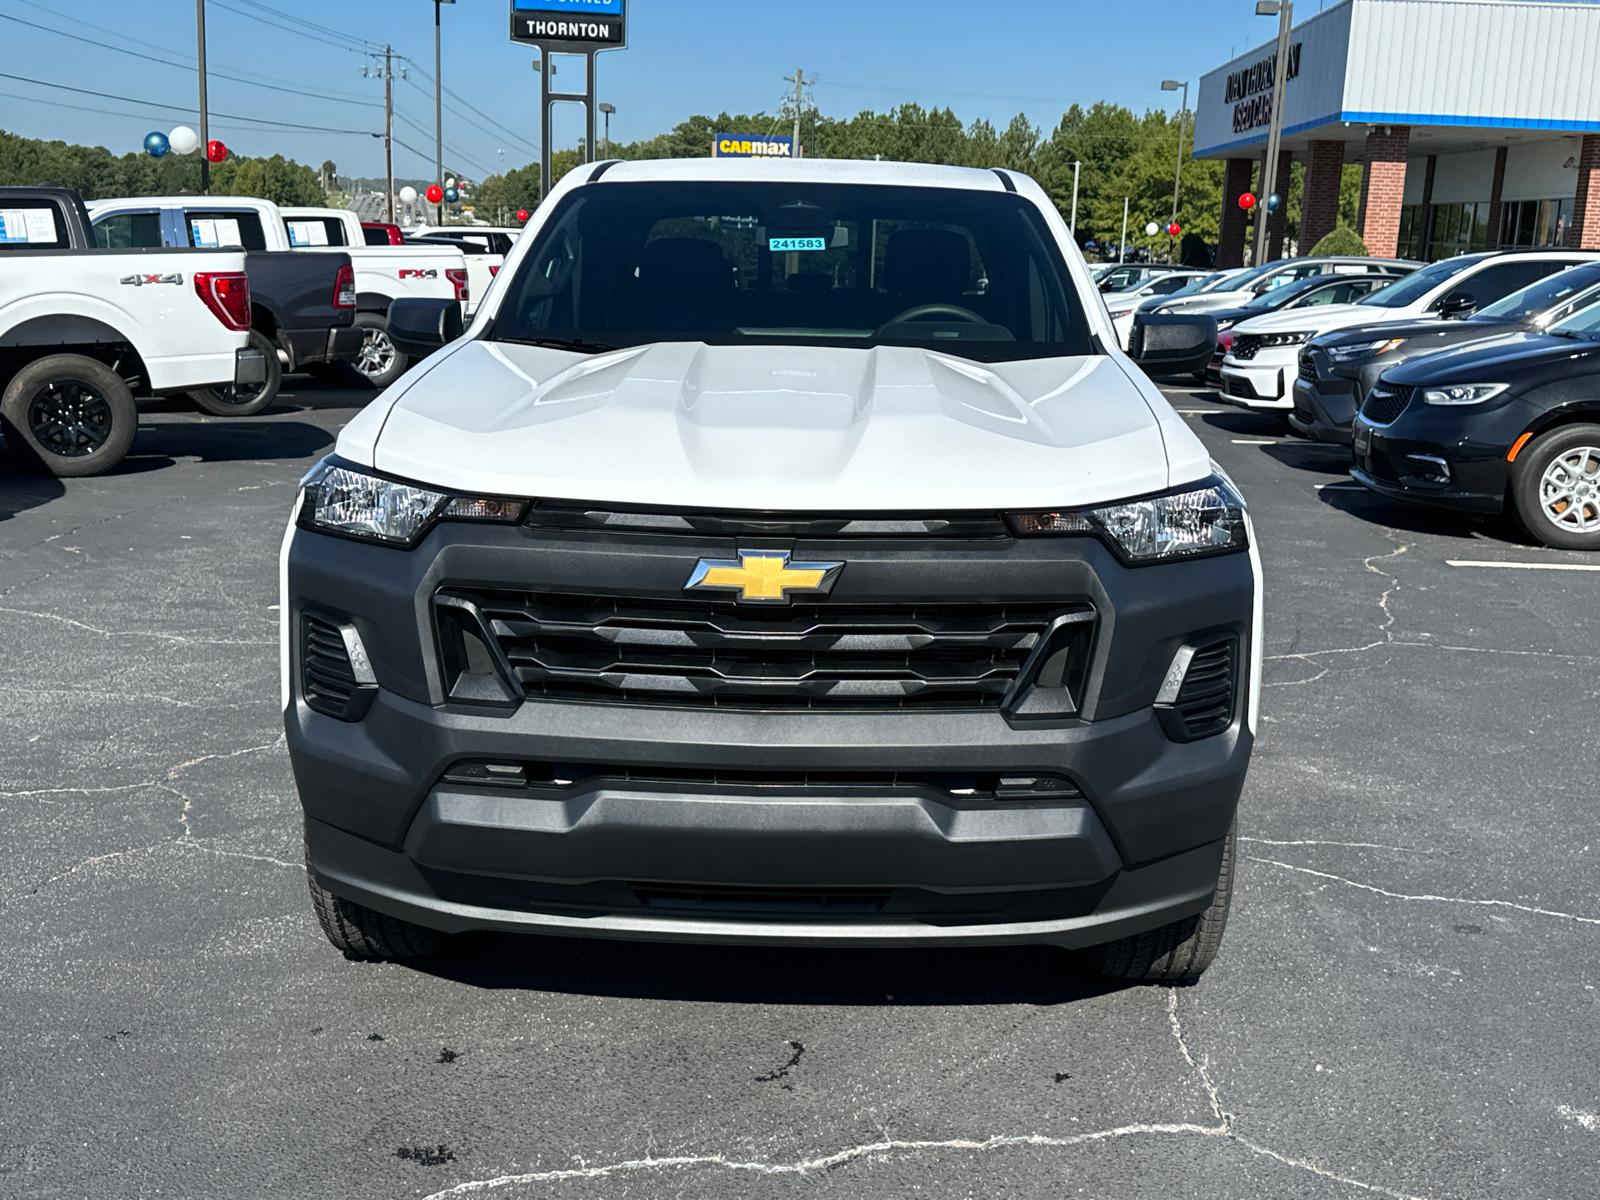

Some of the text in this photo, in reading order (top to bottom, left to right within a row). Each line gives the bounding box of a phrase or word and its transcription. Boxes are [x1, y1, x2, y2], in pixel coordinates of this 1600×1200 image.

[526, 20, 609, 38] THORNTON
[1246, 43, 1302, 95] THORNN
[1232, 101, 1254, 133] USED
[772, 239, 823, 249] 241583
[398, 269, 438, 279] FX4
